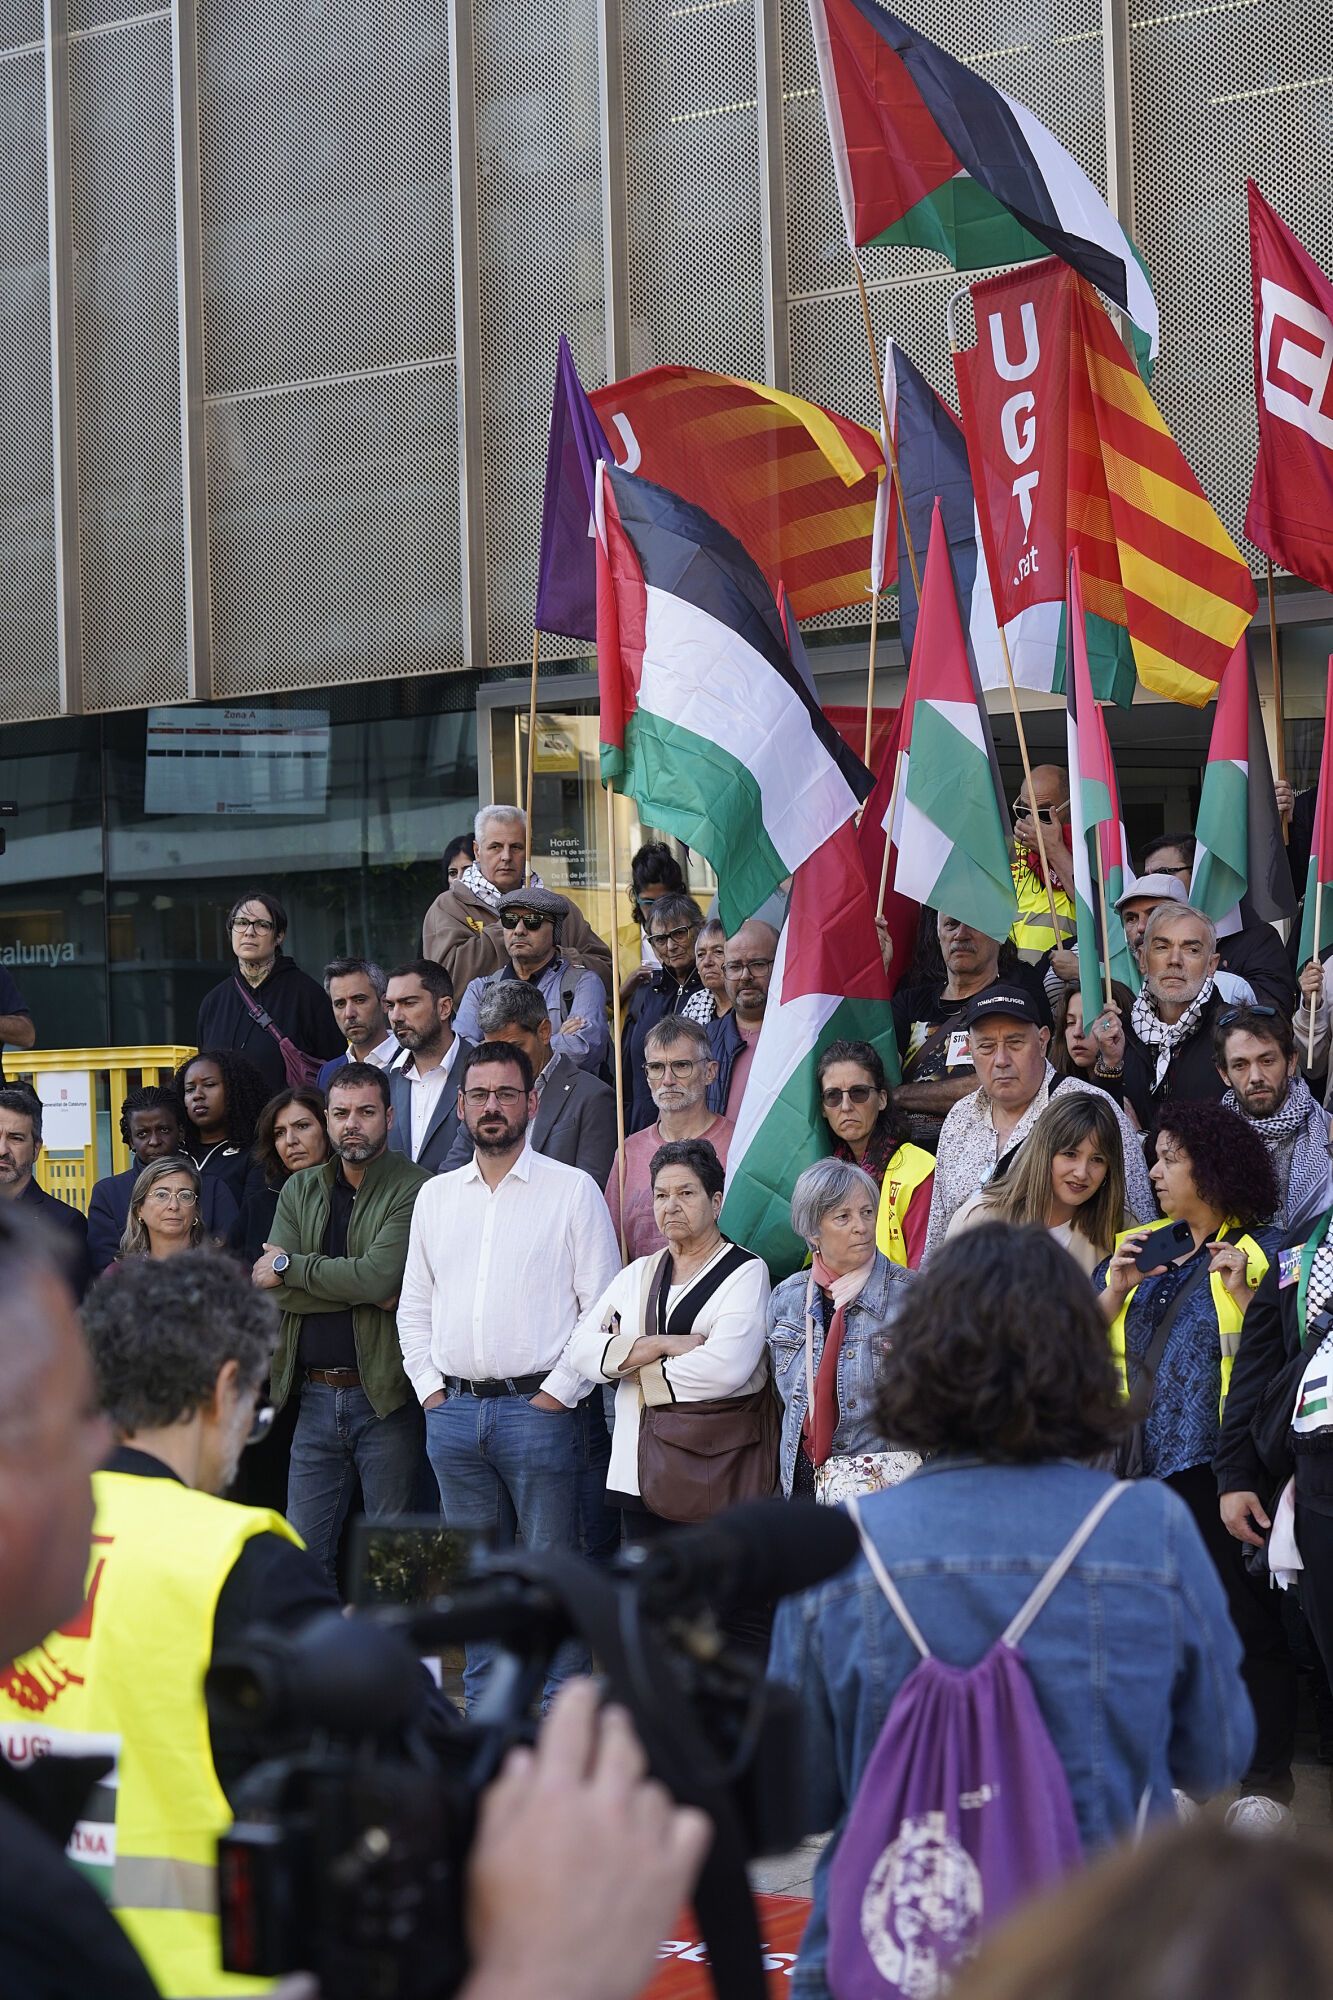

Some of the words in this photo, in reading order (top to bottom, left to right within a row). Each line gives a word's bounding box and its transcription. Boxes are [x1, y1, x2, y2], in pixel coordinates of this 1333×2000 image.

[988, 302, 1041, 545] UGT
[223, 710, 247, 719] Zona
[249, 710, 256, 719] A
[549, 837, 580, 848] Horari:
[952, 1034, 969, 1043] STO
